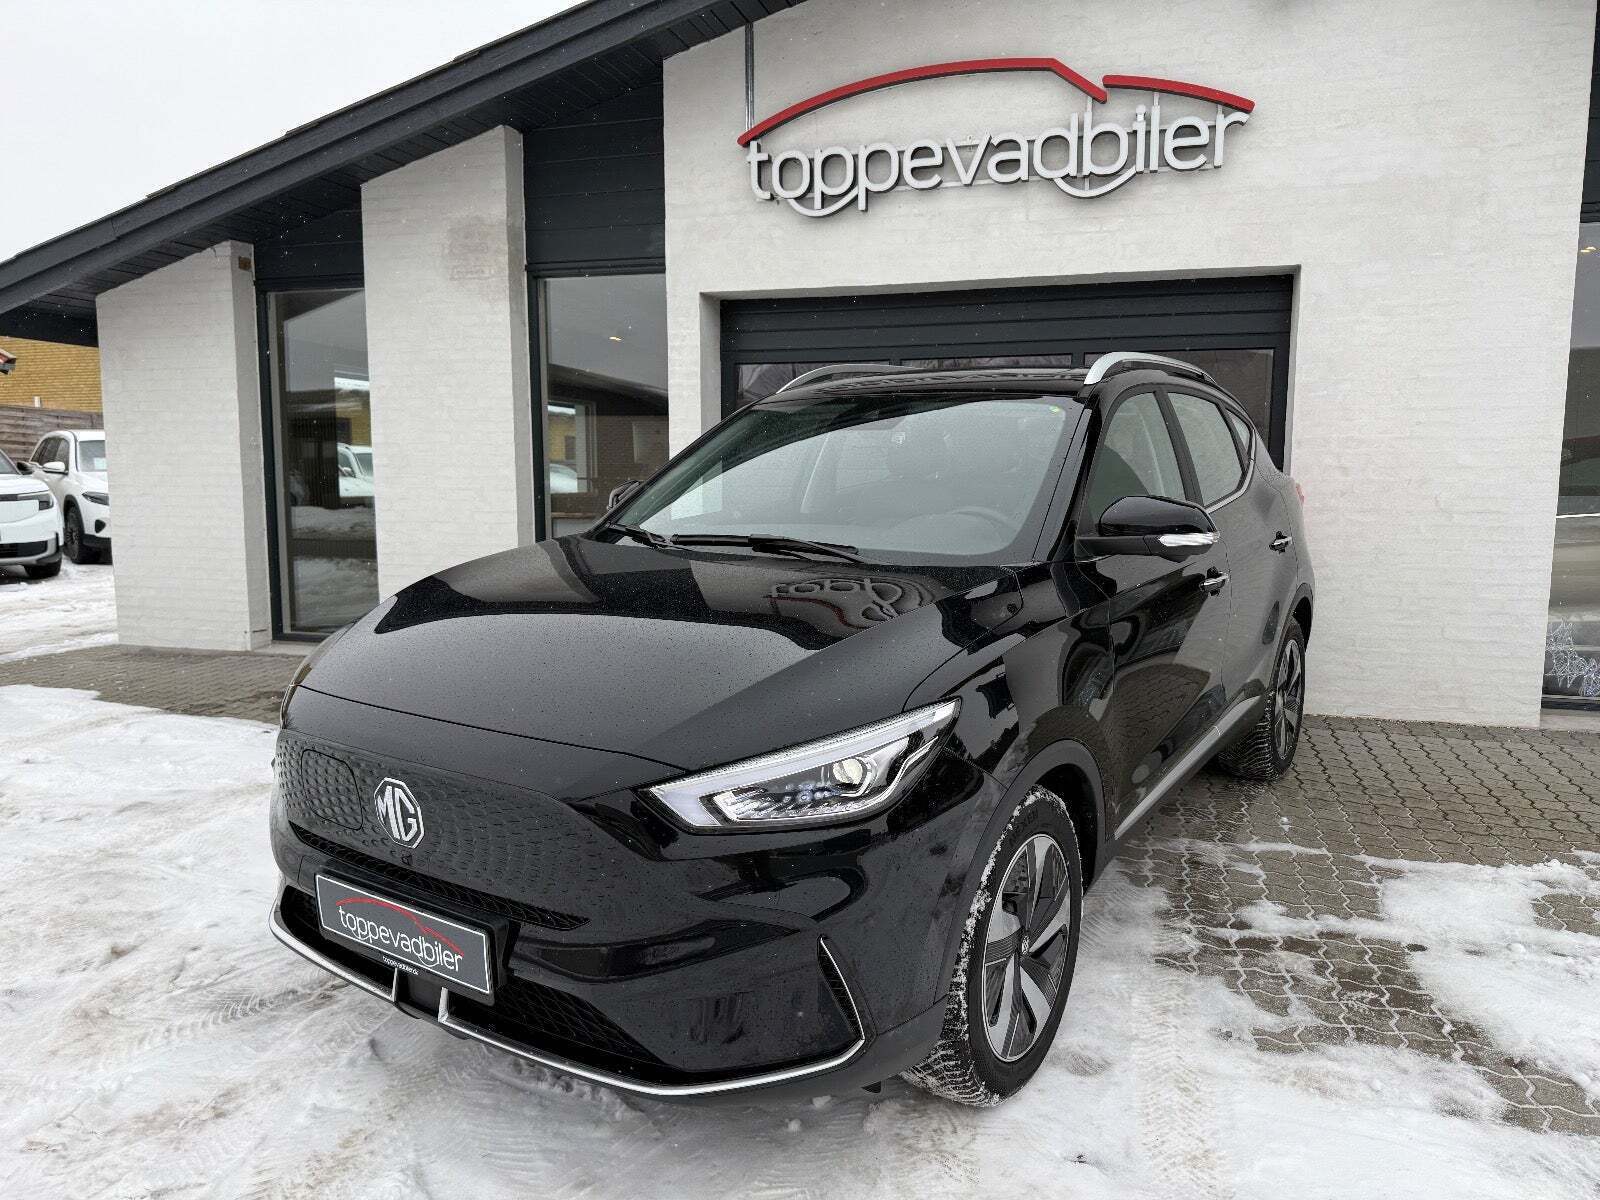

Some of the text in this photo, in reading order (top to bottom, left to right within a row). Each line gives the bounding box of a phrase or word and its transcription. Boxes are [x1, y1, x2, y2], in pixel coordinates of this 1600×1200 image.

[745, 104, 1249, 216] toppevadbiler
[377, 785, 418, 841] MG
[338, 905, 464, 971] toppevadbiler
